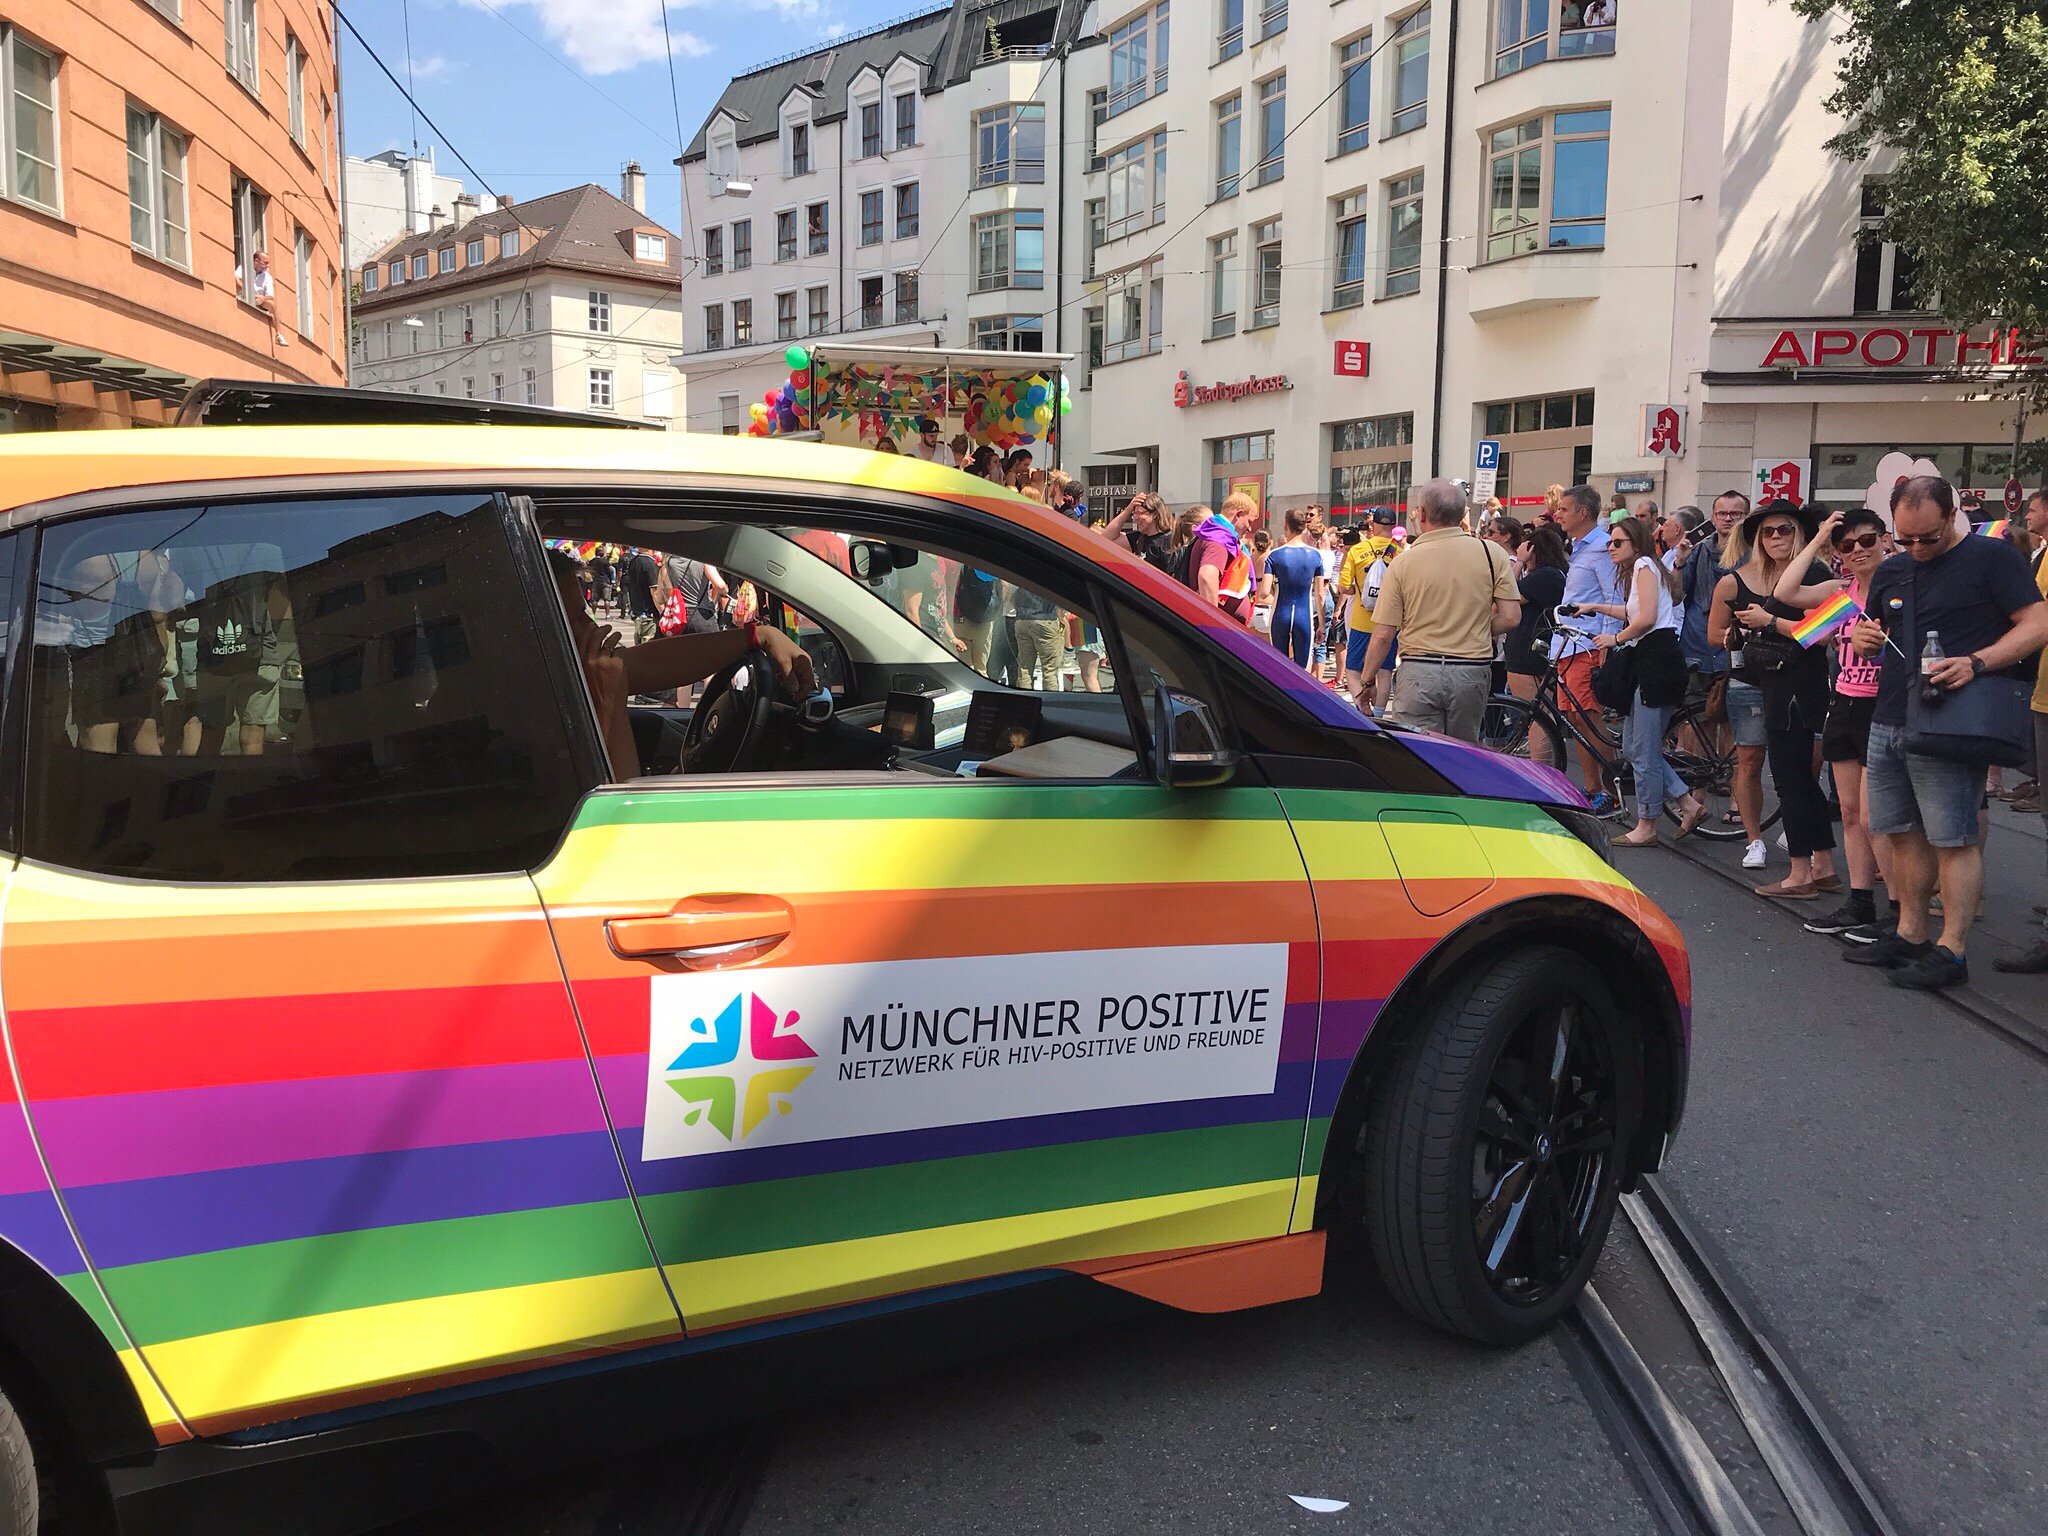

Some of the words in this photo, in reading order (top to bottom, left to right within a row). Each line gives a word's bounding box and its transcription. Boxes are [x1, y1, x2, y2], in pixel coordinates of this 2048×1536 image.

[1194, 375, 1287, 403] Stadtsparkasse
[1480, 445, 1493, 466] P
[1089, 486, 1127, 497] TOBIAS
[212, 643, 247, 655] adidas
[841, 1000, 1081, 1055] MÜNCHNER
[1098, 988, 1270, 1033] POSITIVE
[838, 1053, 955, 1081] NETZWERK
[962, 1046, 1000, 1069] FÜR
[1008, 1037, 1137, 1064] HIV-POSITIVE
[1143, 1034, 1181, 1052] UND
[1187, 1029, 1265, 1048] FREUNDE
